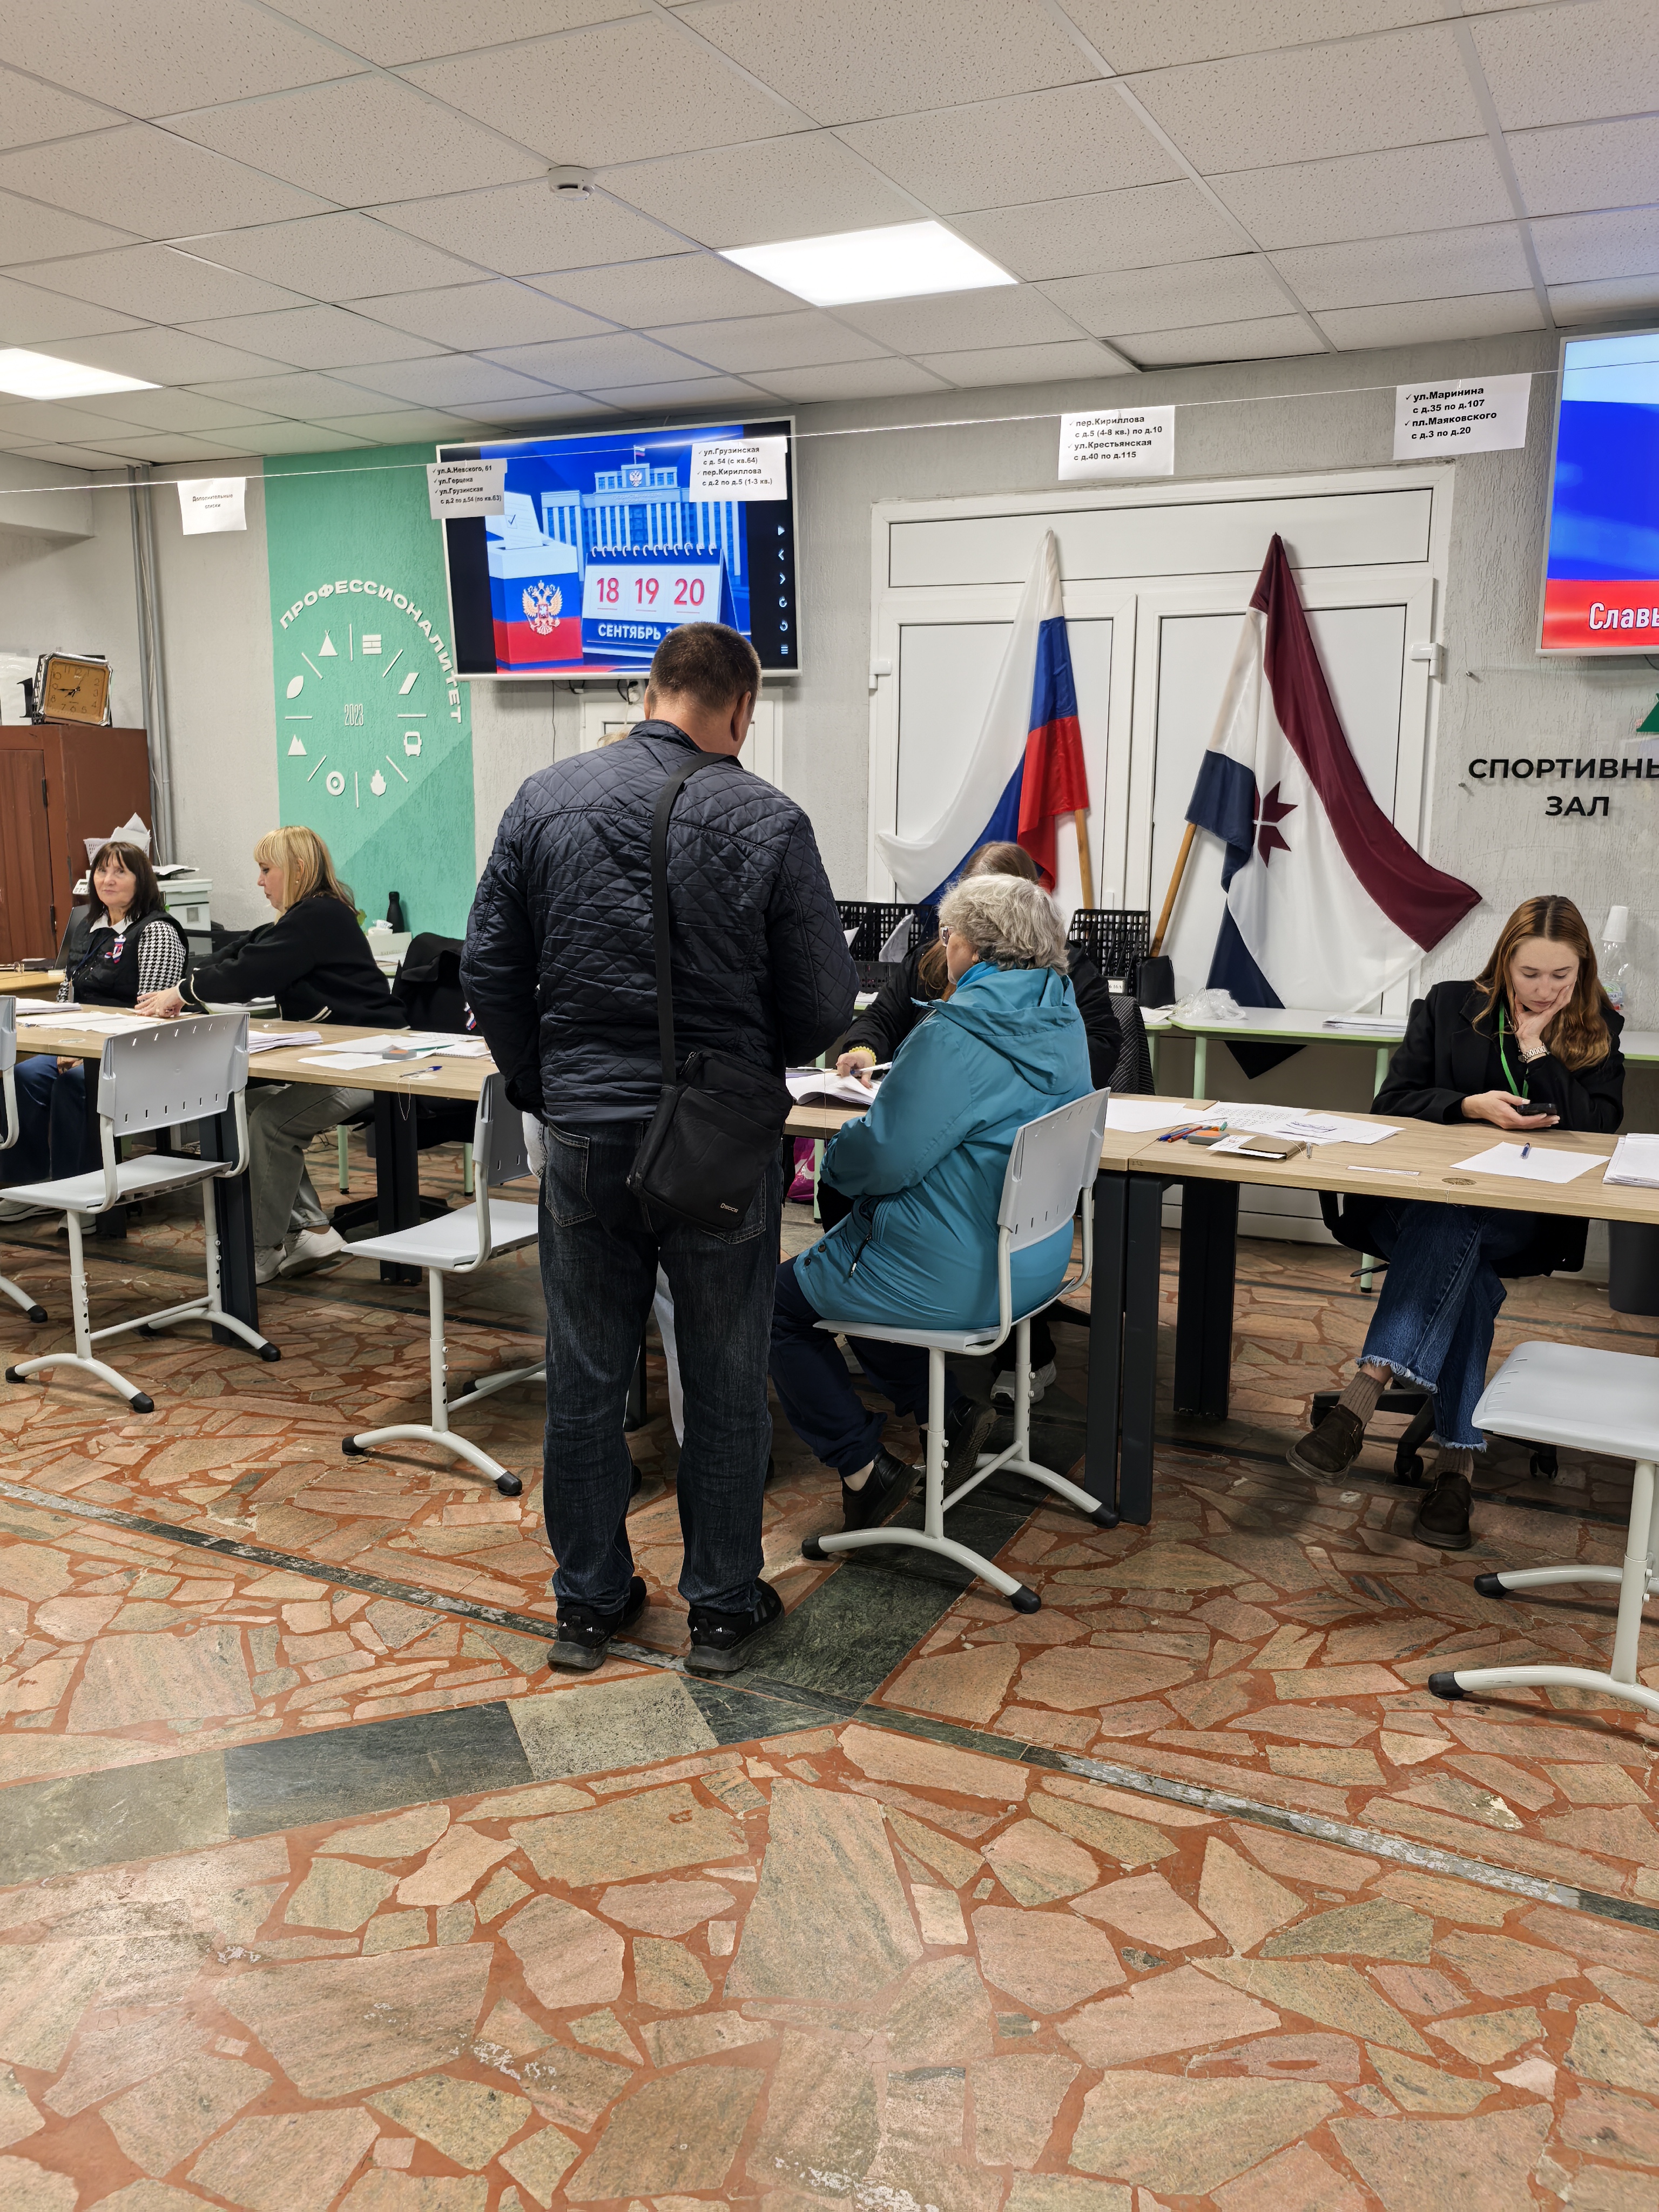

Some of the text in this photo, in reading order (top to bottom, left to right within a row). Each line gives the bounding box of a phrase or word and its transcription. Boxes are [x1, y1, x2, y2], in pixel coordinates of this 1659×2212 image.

[1413, 388, 1484, 402] ул.Маринина
[1421, 404, 1441, 414] д.35
[1458, 400, 1485, 410] д.107
[1076, 416, 1144, 427] пер.Кириллова
[1412, 413, 1497, 427] пл.Маяковского
[1097, 429, 1112, 437] (4-8
[1145, 426, 1162, 434] д.10
[1420, 431, 1434, 440] д.3
[1451, 427, 1471, 437] д.20
[704, 447, 759, 456] ул.Грузинская
[1074, 439, 1151, 451] ул.Крестьянская
[1113, 451, 1136, 460] д.115
[437, 467, 483, 475] ул.А.Невского,
[439, 477, 473, 485] ул.Герцена
[440, 487, 483, 496] ул.Грузинская
[597, 578, 704, 606] 18 19 20
[598, 624, 661, 640] СЕНТЯБРЬ
[280, 579, 462, 724] ПРОФЕССИОНАЛИТЕТ
[345, 704, 364, 726] 2023
[1546, 797, 1609, 816] ЗАЛ
